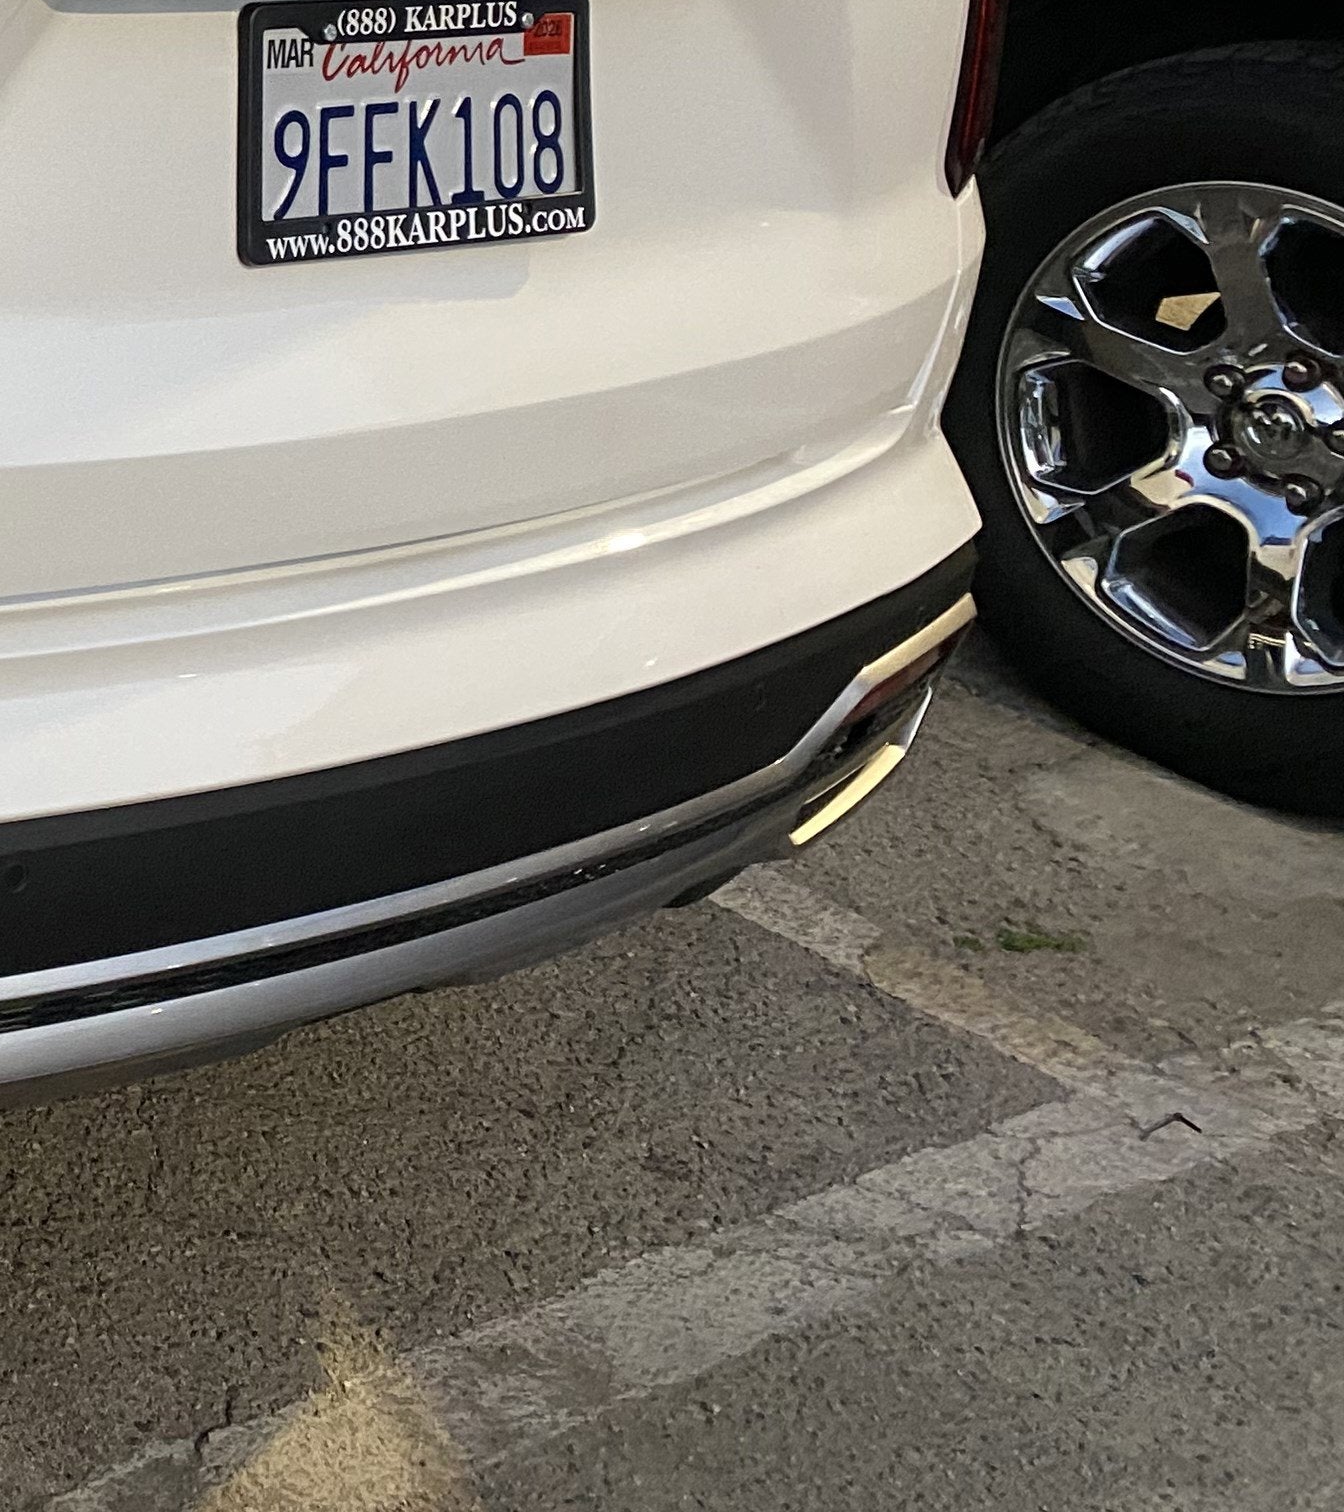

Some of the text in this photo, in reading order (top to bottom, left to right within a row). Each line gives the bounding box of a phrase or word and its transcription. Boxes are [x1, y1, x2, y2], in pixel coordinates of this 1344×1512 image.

[337, 1, 517, 36] (888) KARPLUS
[266, 39, 314, 69] MAR
[322, 38, 525, 93] California
[273, 89, 564, 220] 9FFK108
